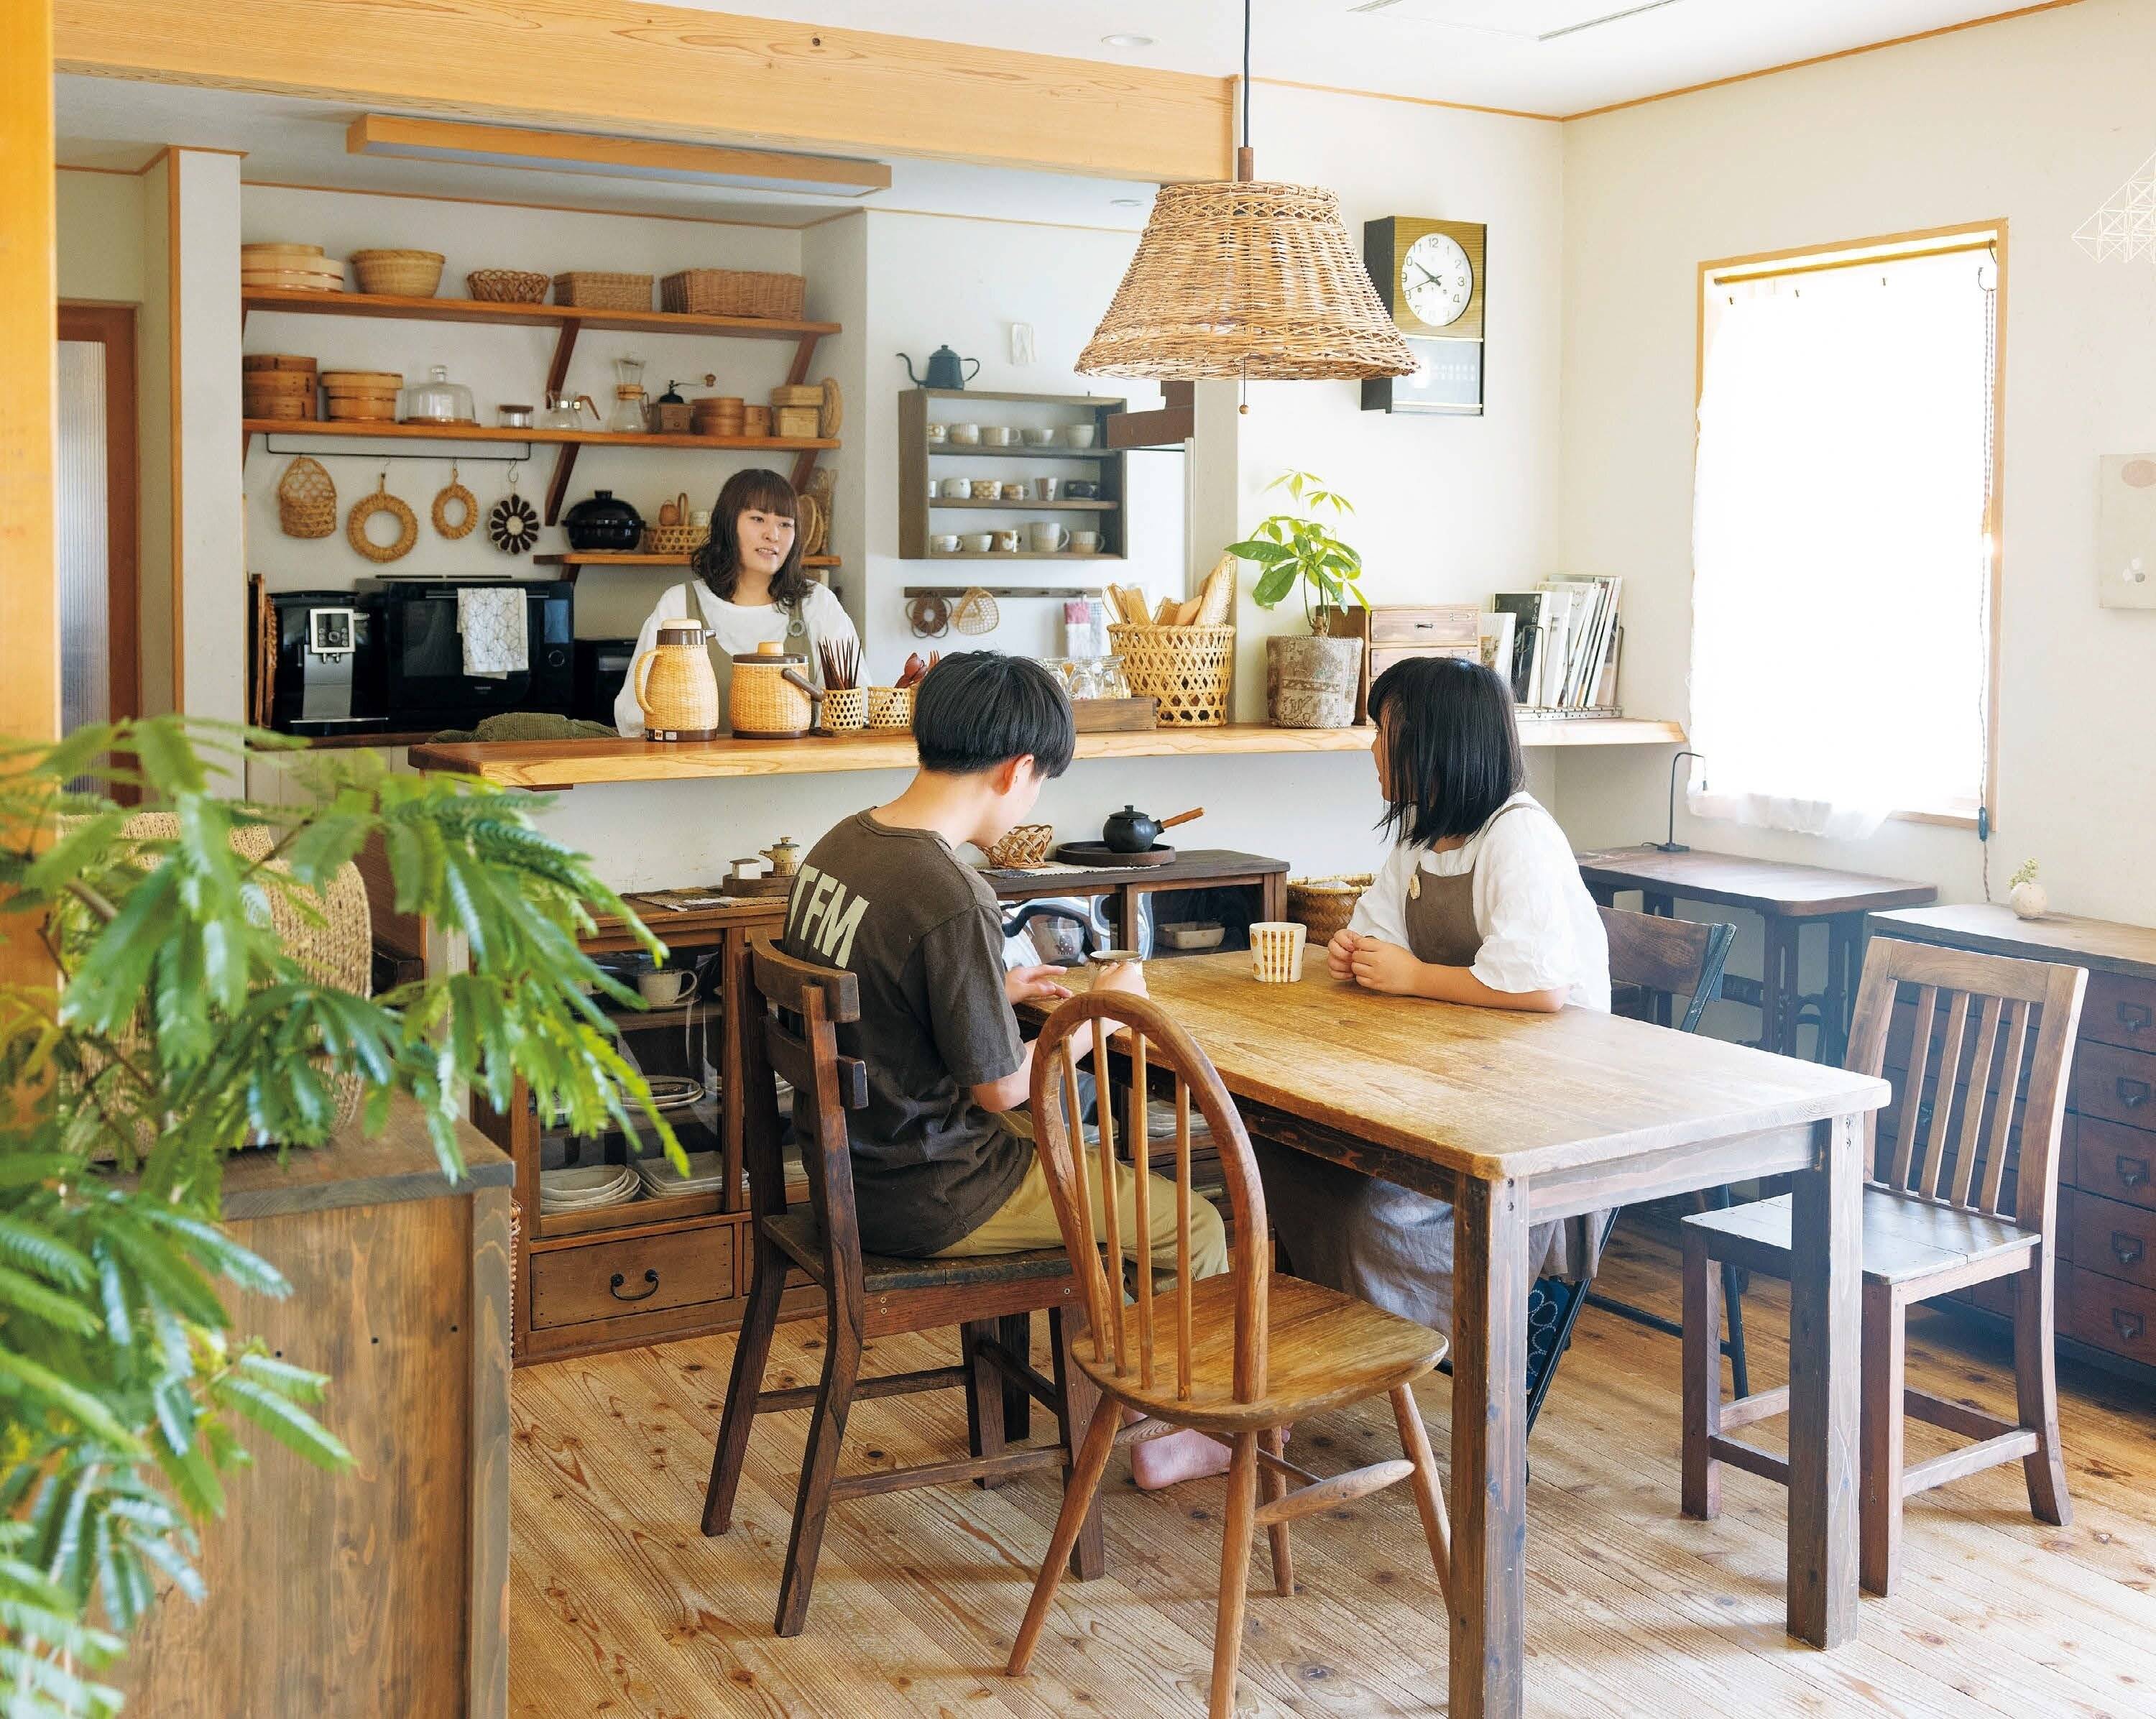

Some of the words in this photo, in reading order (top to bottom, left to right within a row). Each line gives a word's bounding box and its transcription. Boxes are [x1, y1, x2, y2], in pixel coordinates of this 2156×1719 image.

[1429, 237, 1439, 248] 12
[1455, 259, 1461, 269] 2
[1457, 276, 1465, 287] 3
[1452, 294, 1460, 303] 4
